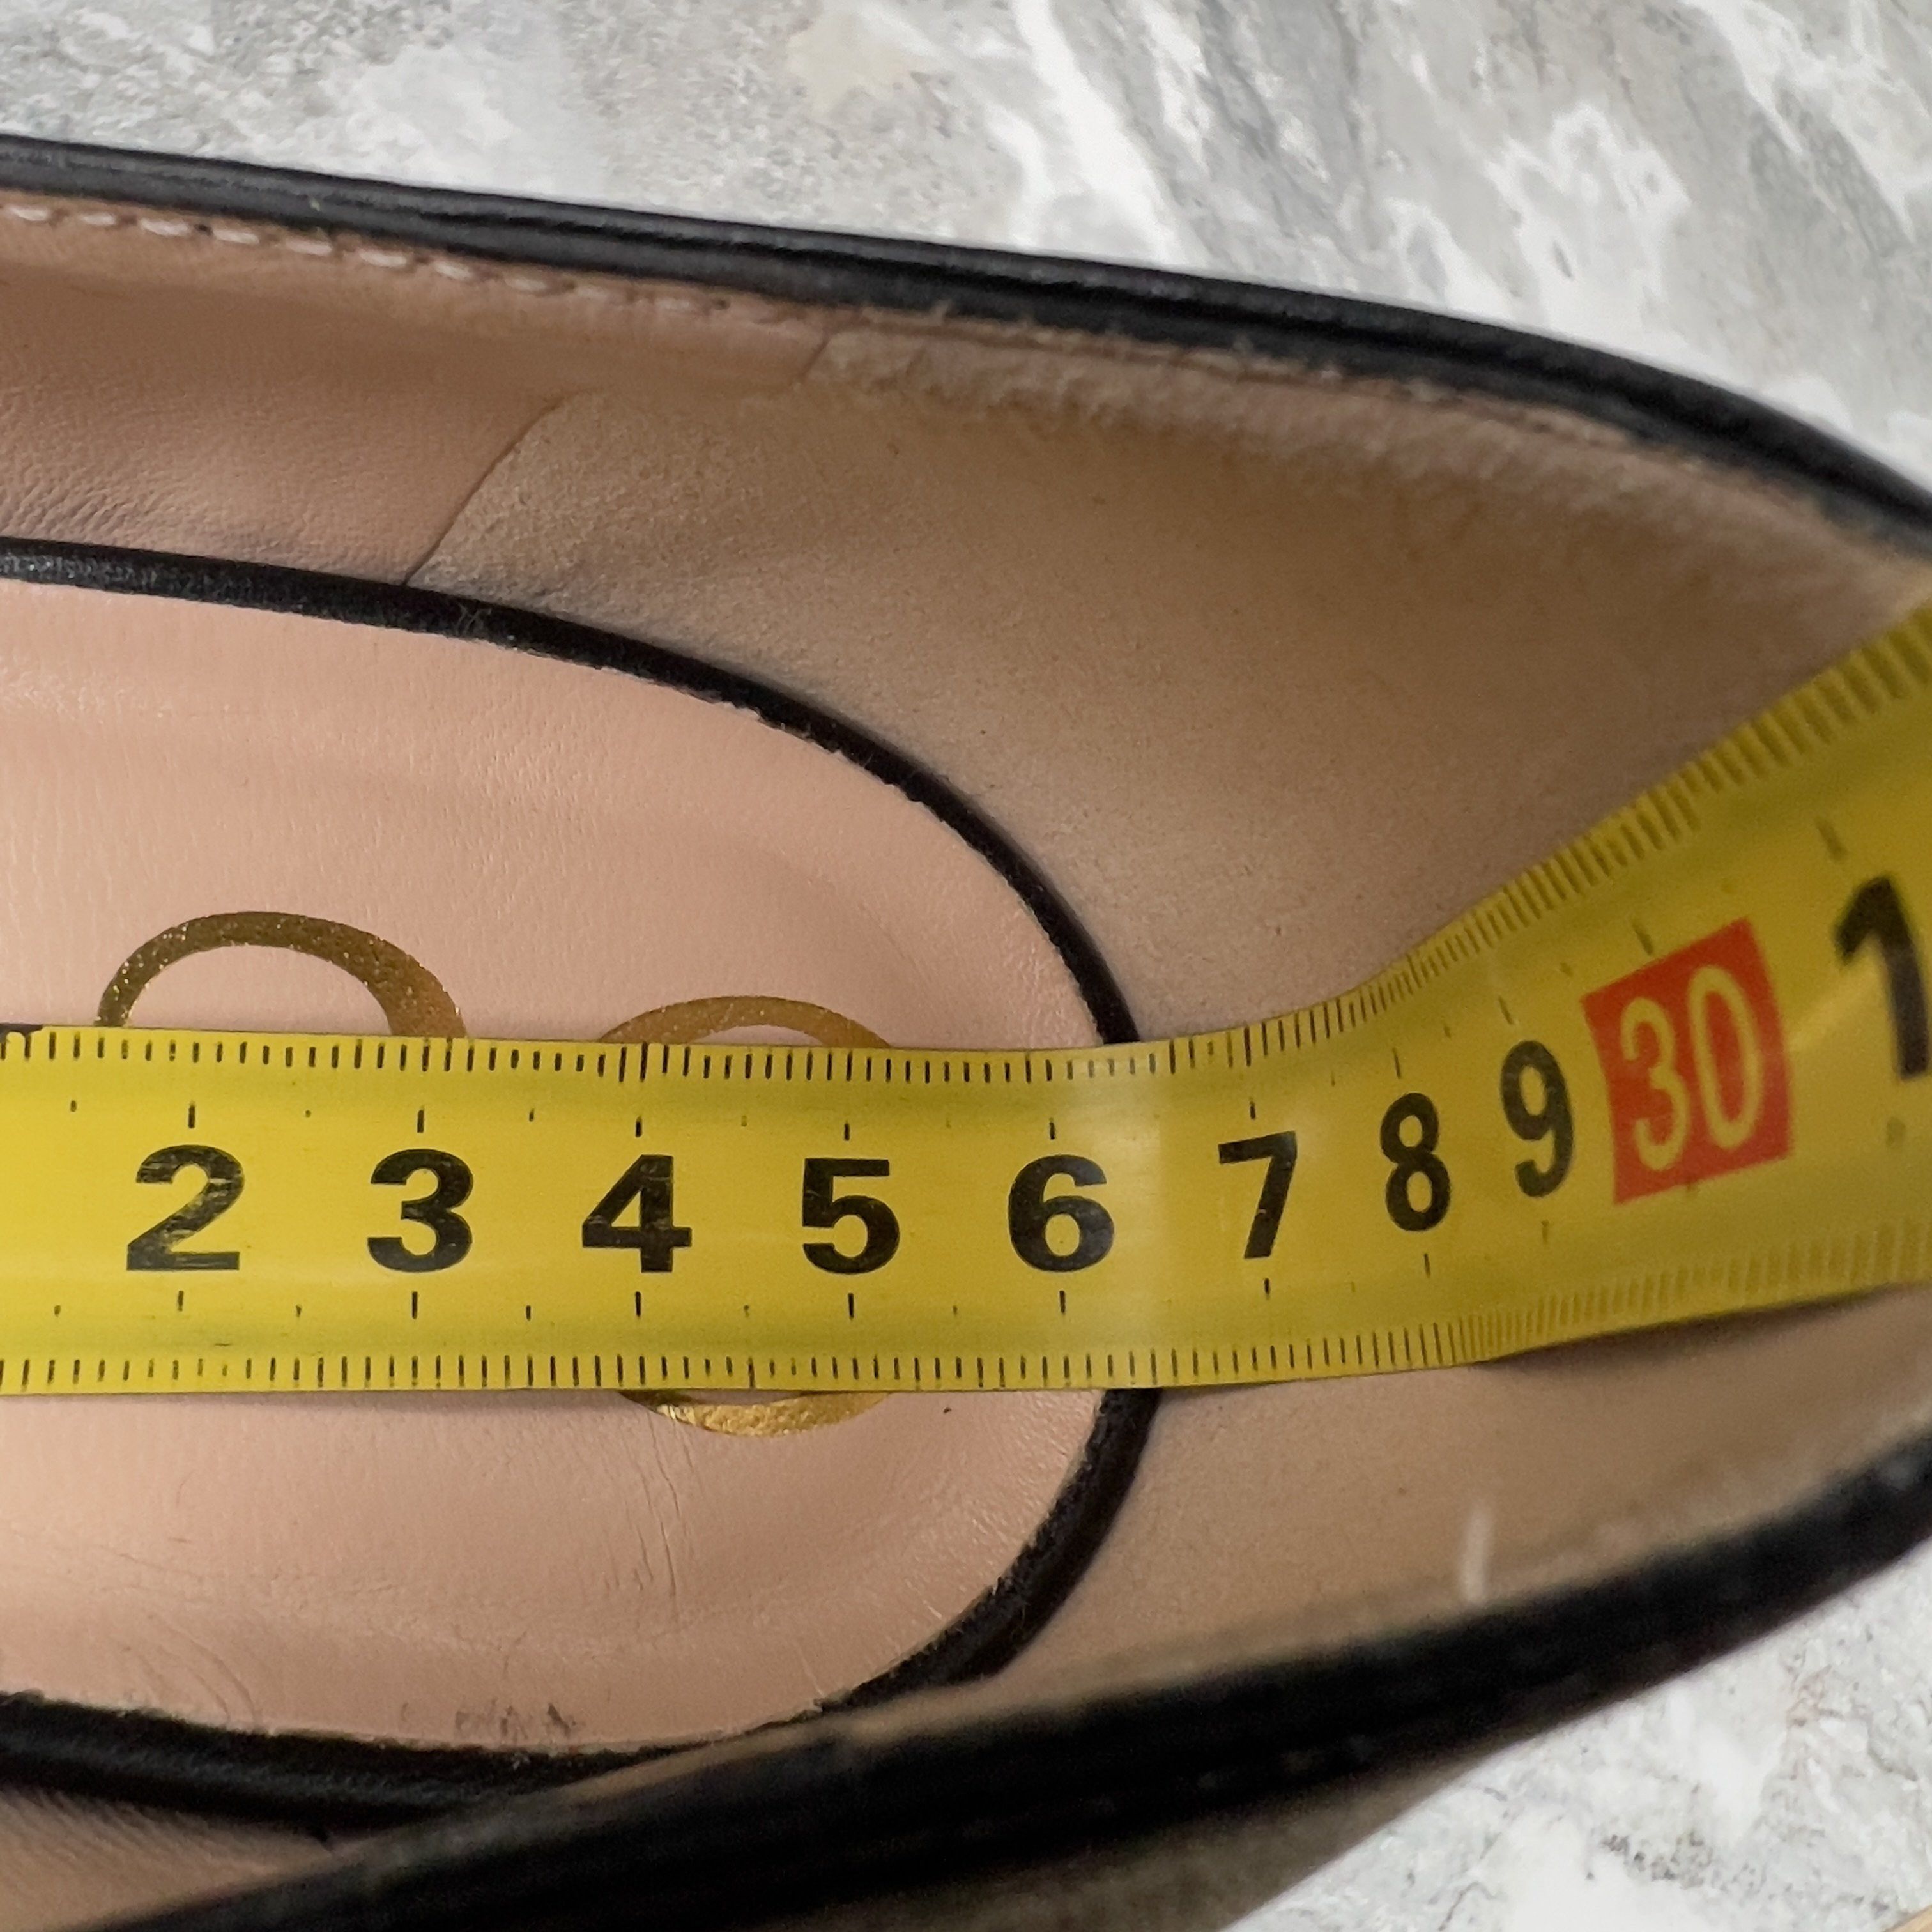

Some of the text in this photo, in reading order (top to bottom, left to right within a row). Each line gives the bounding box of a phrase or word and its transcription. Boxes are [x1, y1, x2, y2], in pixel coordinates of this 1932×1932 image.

[126, 874, 1931, 1275] 2 3 4 5 6 7 8 9 30 1
